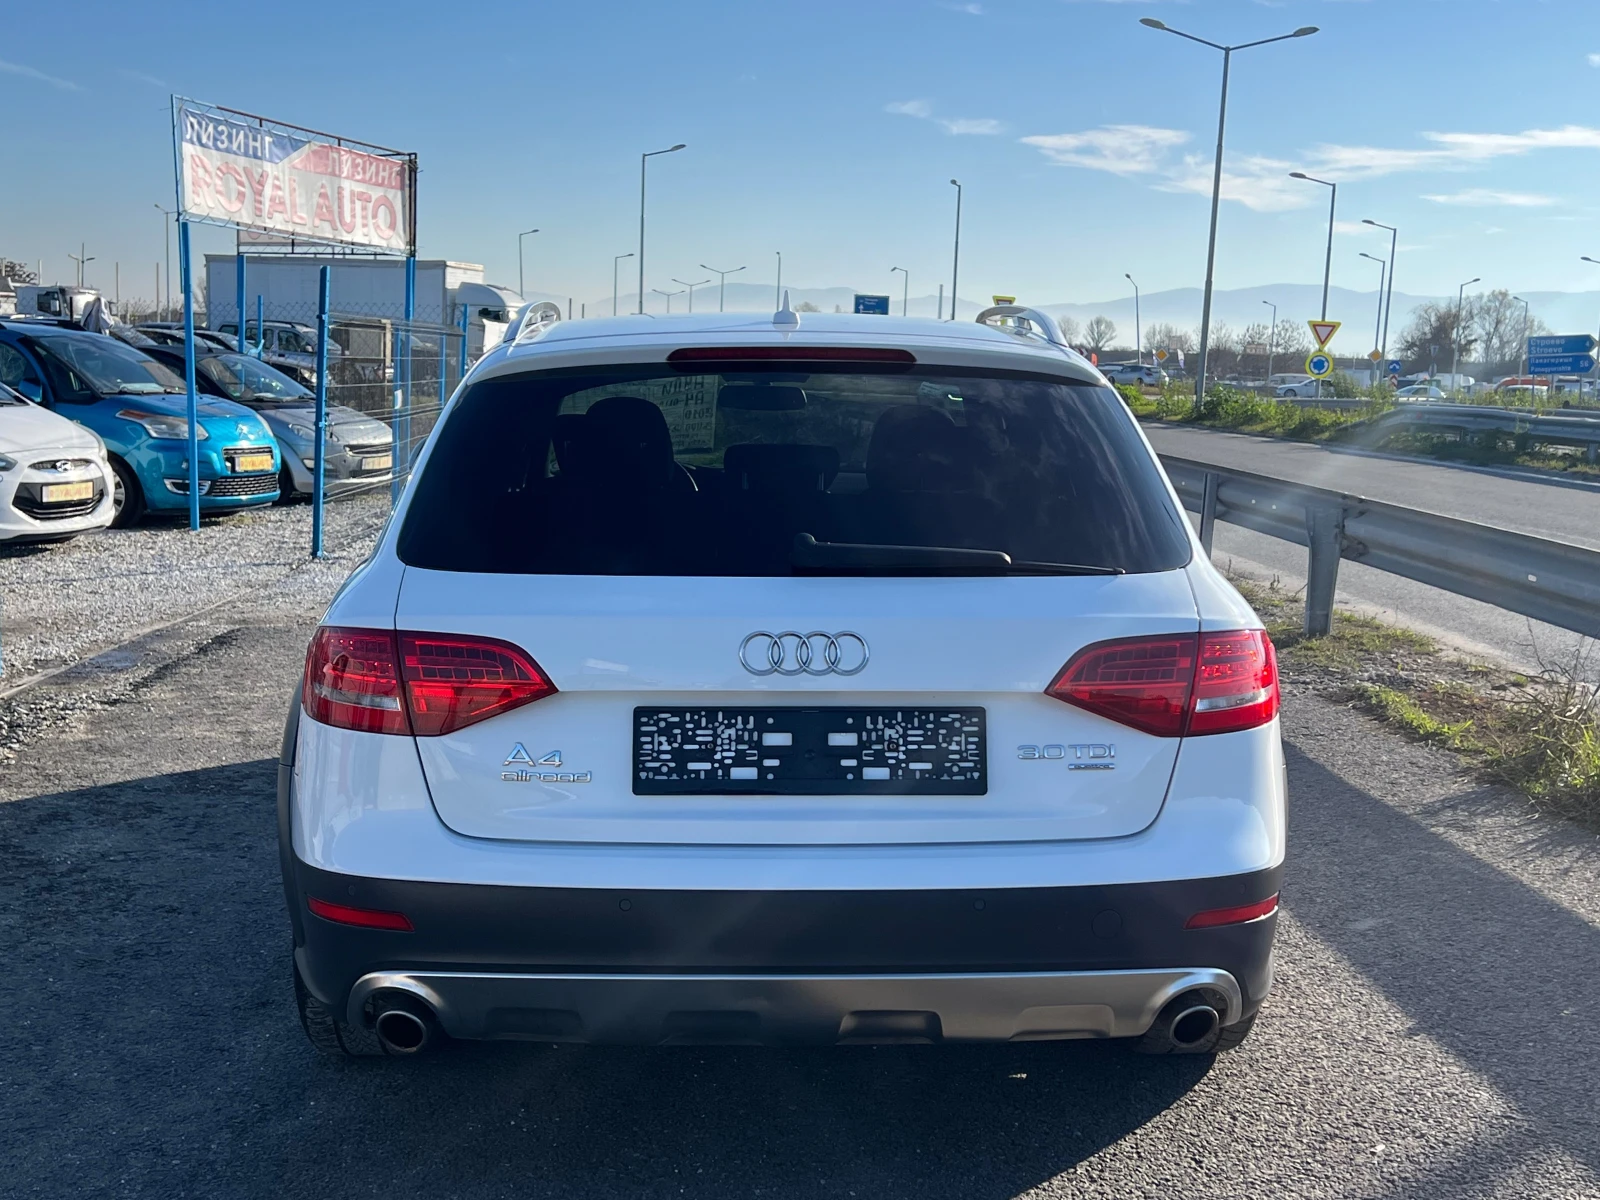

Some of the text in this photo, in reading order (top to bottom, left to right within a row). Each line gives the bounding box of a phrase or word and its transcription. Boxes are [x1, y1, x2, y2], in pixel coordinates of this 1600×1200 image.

[185, 115, 273, 159] ЛИЗИНГ
[328, 150, 401, 186] ЛИЗИНГ
[190, 154, 397, 240] ROYAL AUTO
[1530, 338, 1565, 347] Строево
[1531, 346, 1563, 354] Stroevo
[1579, 360, 1589, 368] 56
[502, 741, 563, 767] A4
[501, 769, 592, 783] allroad
